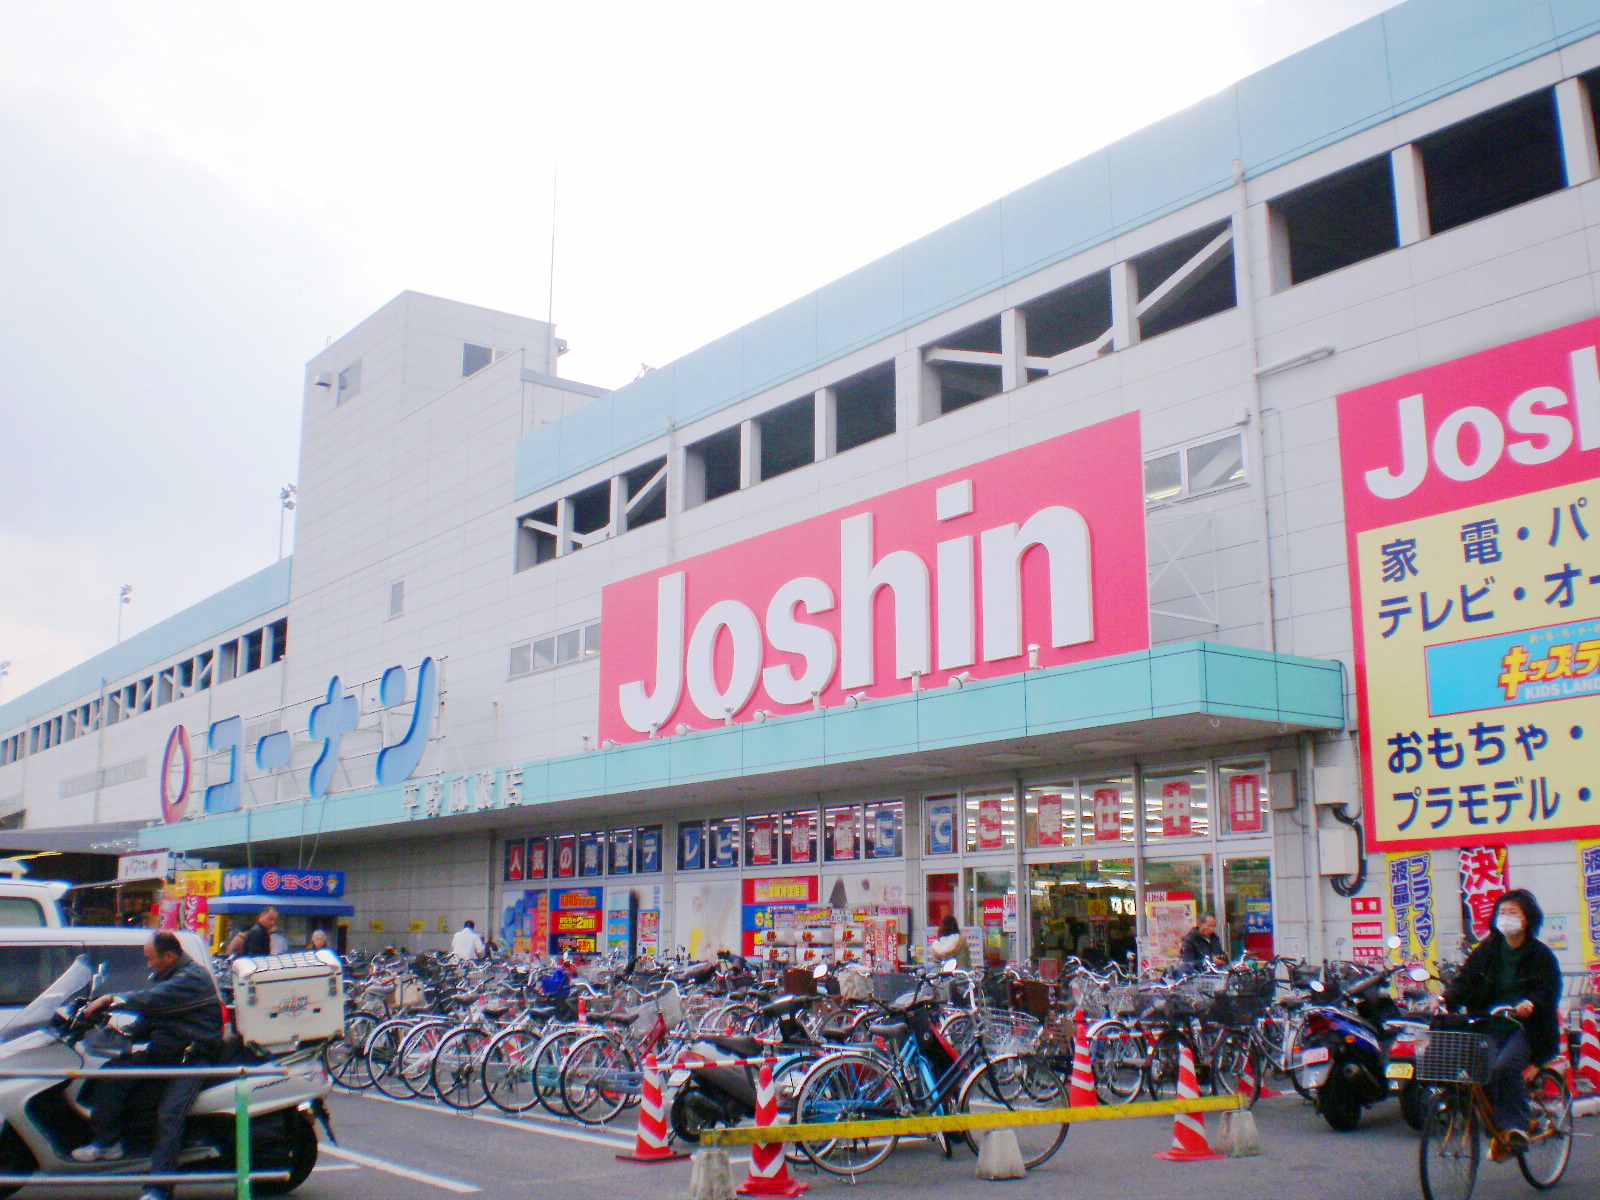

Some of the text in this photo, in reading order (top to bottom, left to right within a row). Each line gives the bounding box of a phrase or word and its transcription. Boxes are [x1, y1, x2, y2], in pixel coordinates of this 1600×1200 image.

[619, 479, 1094, 732] Joshin
[204, 656, 437, 814] コーナン
[1526, 684, 1560, 699] KIDS
[281, 874, 324, 891] 宝くじ
